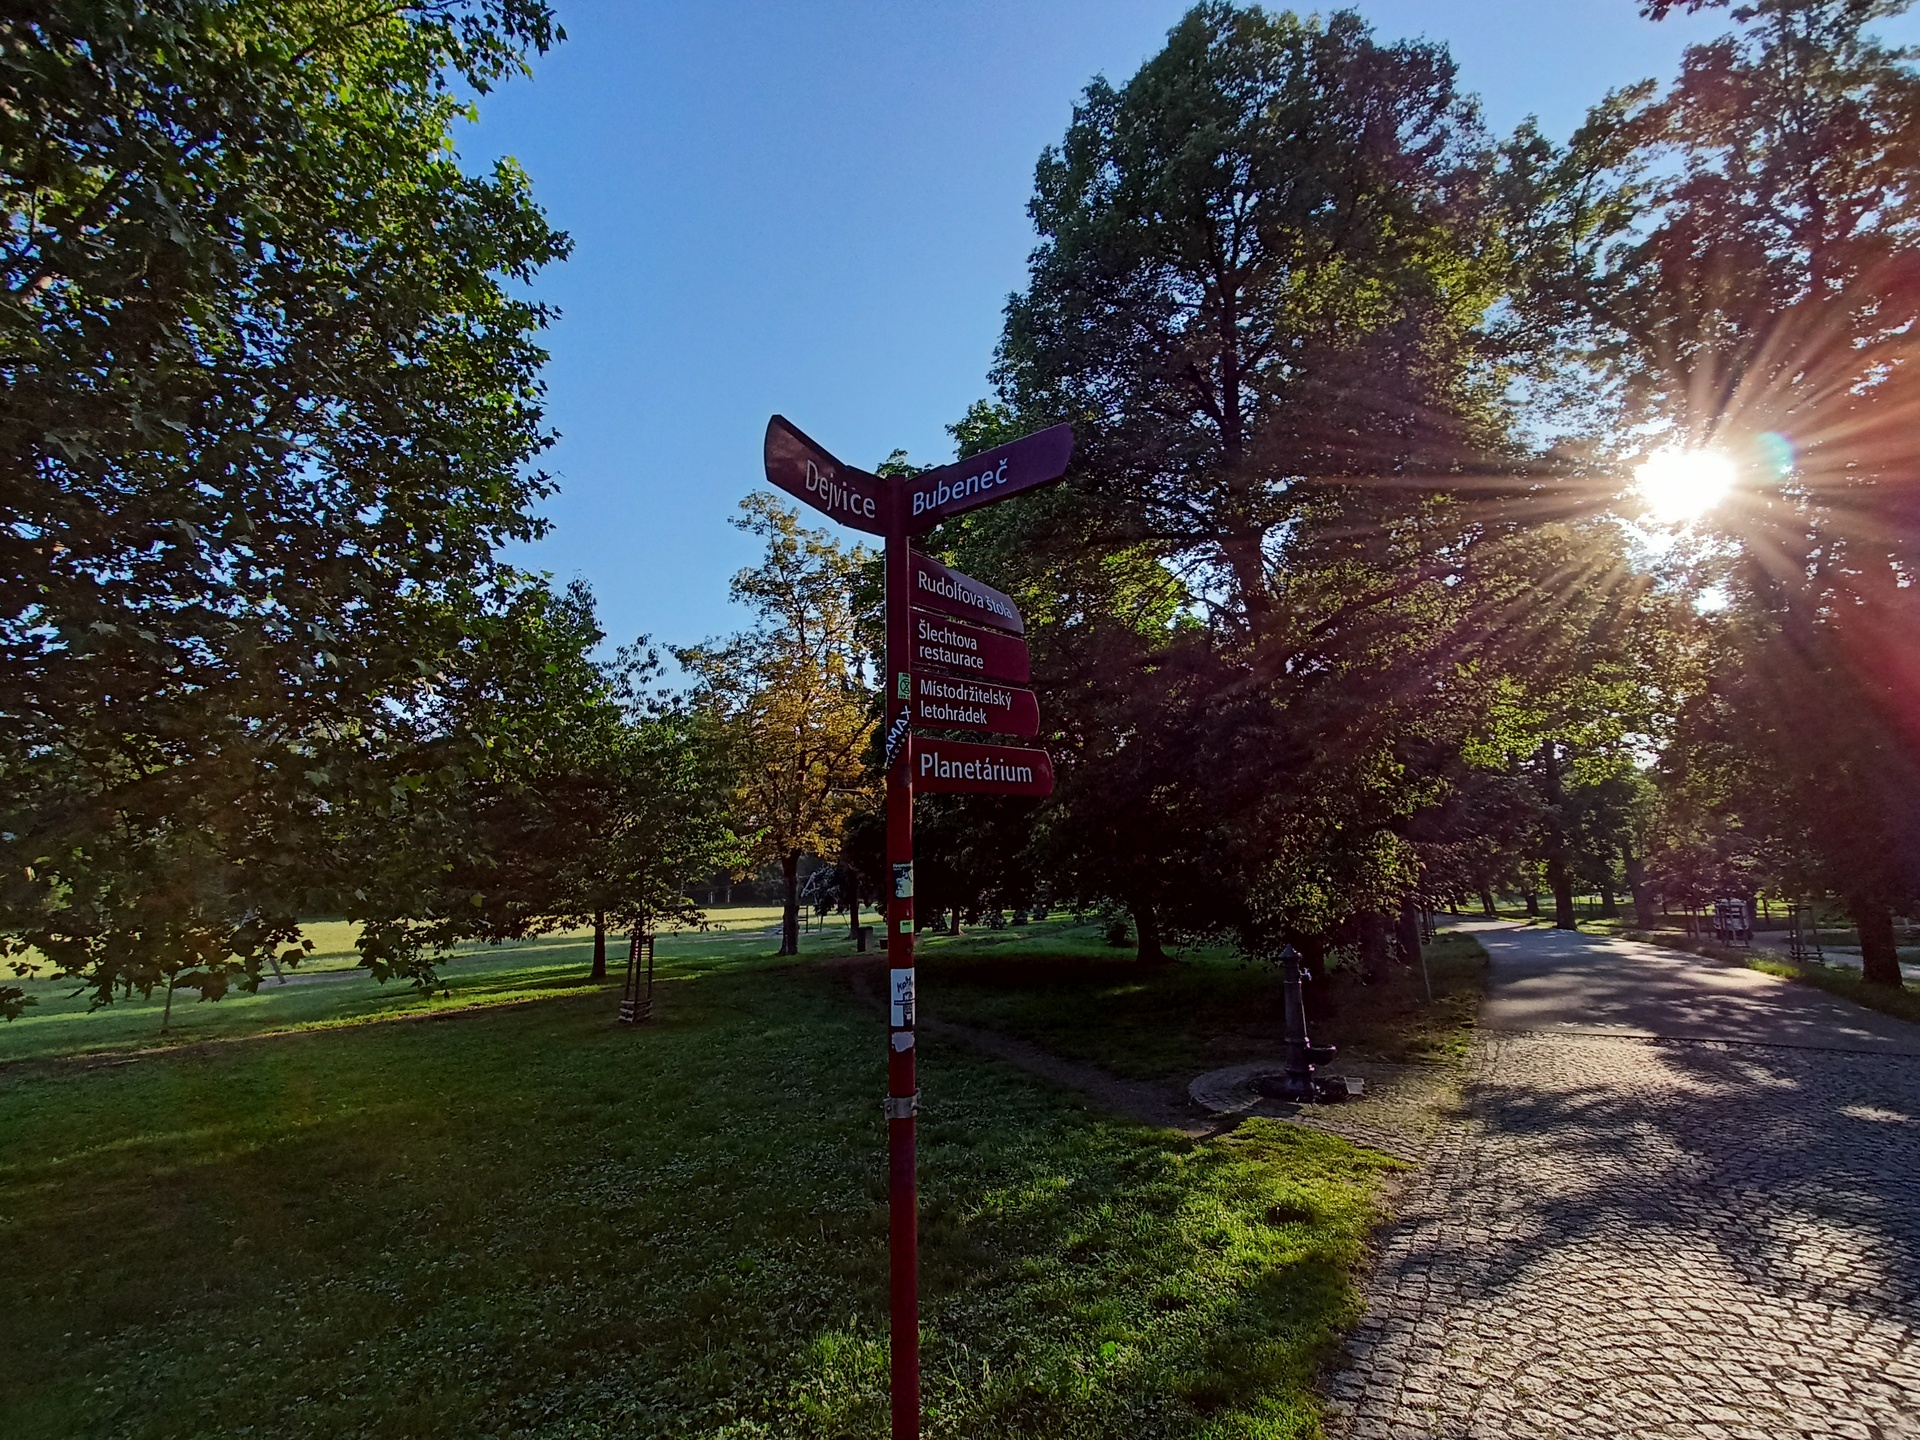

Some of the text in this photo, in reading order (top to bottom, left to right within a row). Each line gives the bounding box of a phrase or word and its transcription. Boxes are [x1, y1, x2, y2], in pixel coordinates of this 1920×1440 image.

[804, 458, 876, 519] Dejvice
[912, 458, 1009, 516] Bubeneč
[918, 570, 1013, 620] Rudolfova štola
[918, 619, 978, 650] Šlechtova
[918, 645, 984, 670] restaurace
[919, 679, 1012, 711] Místodržitelský
[920, 700, 987, 725] letohrádek
[920, 753, 1033, 783] Planetárium
